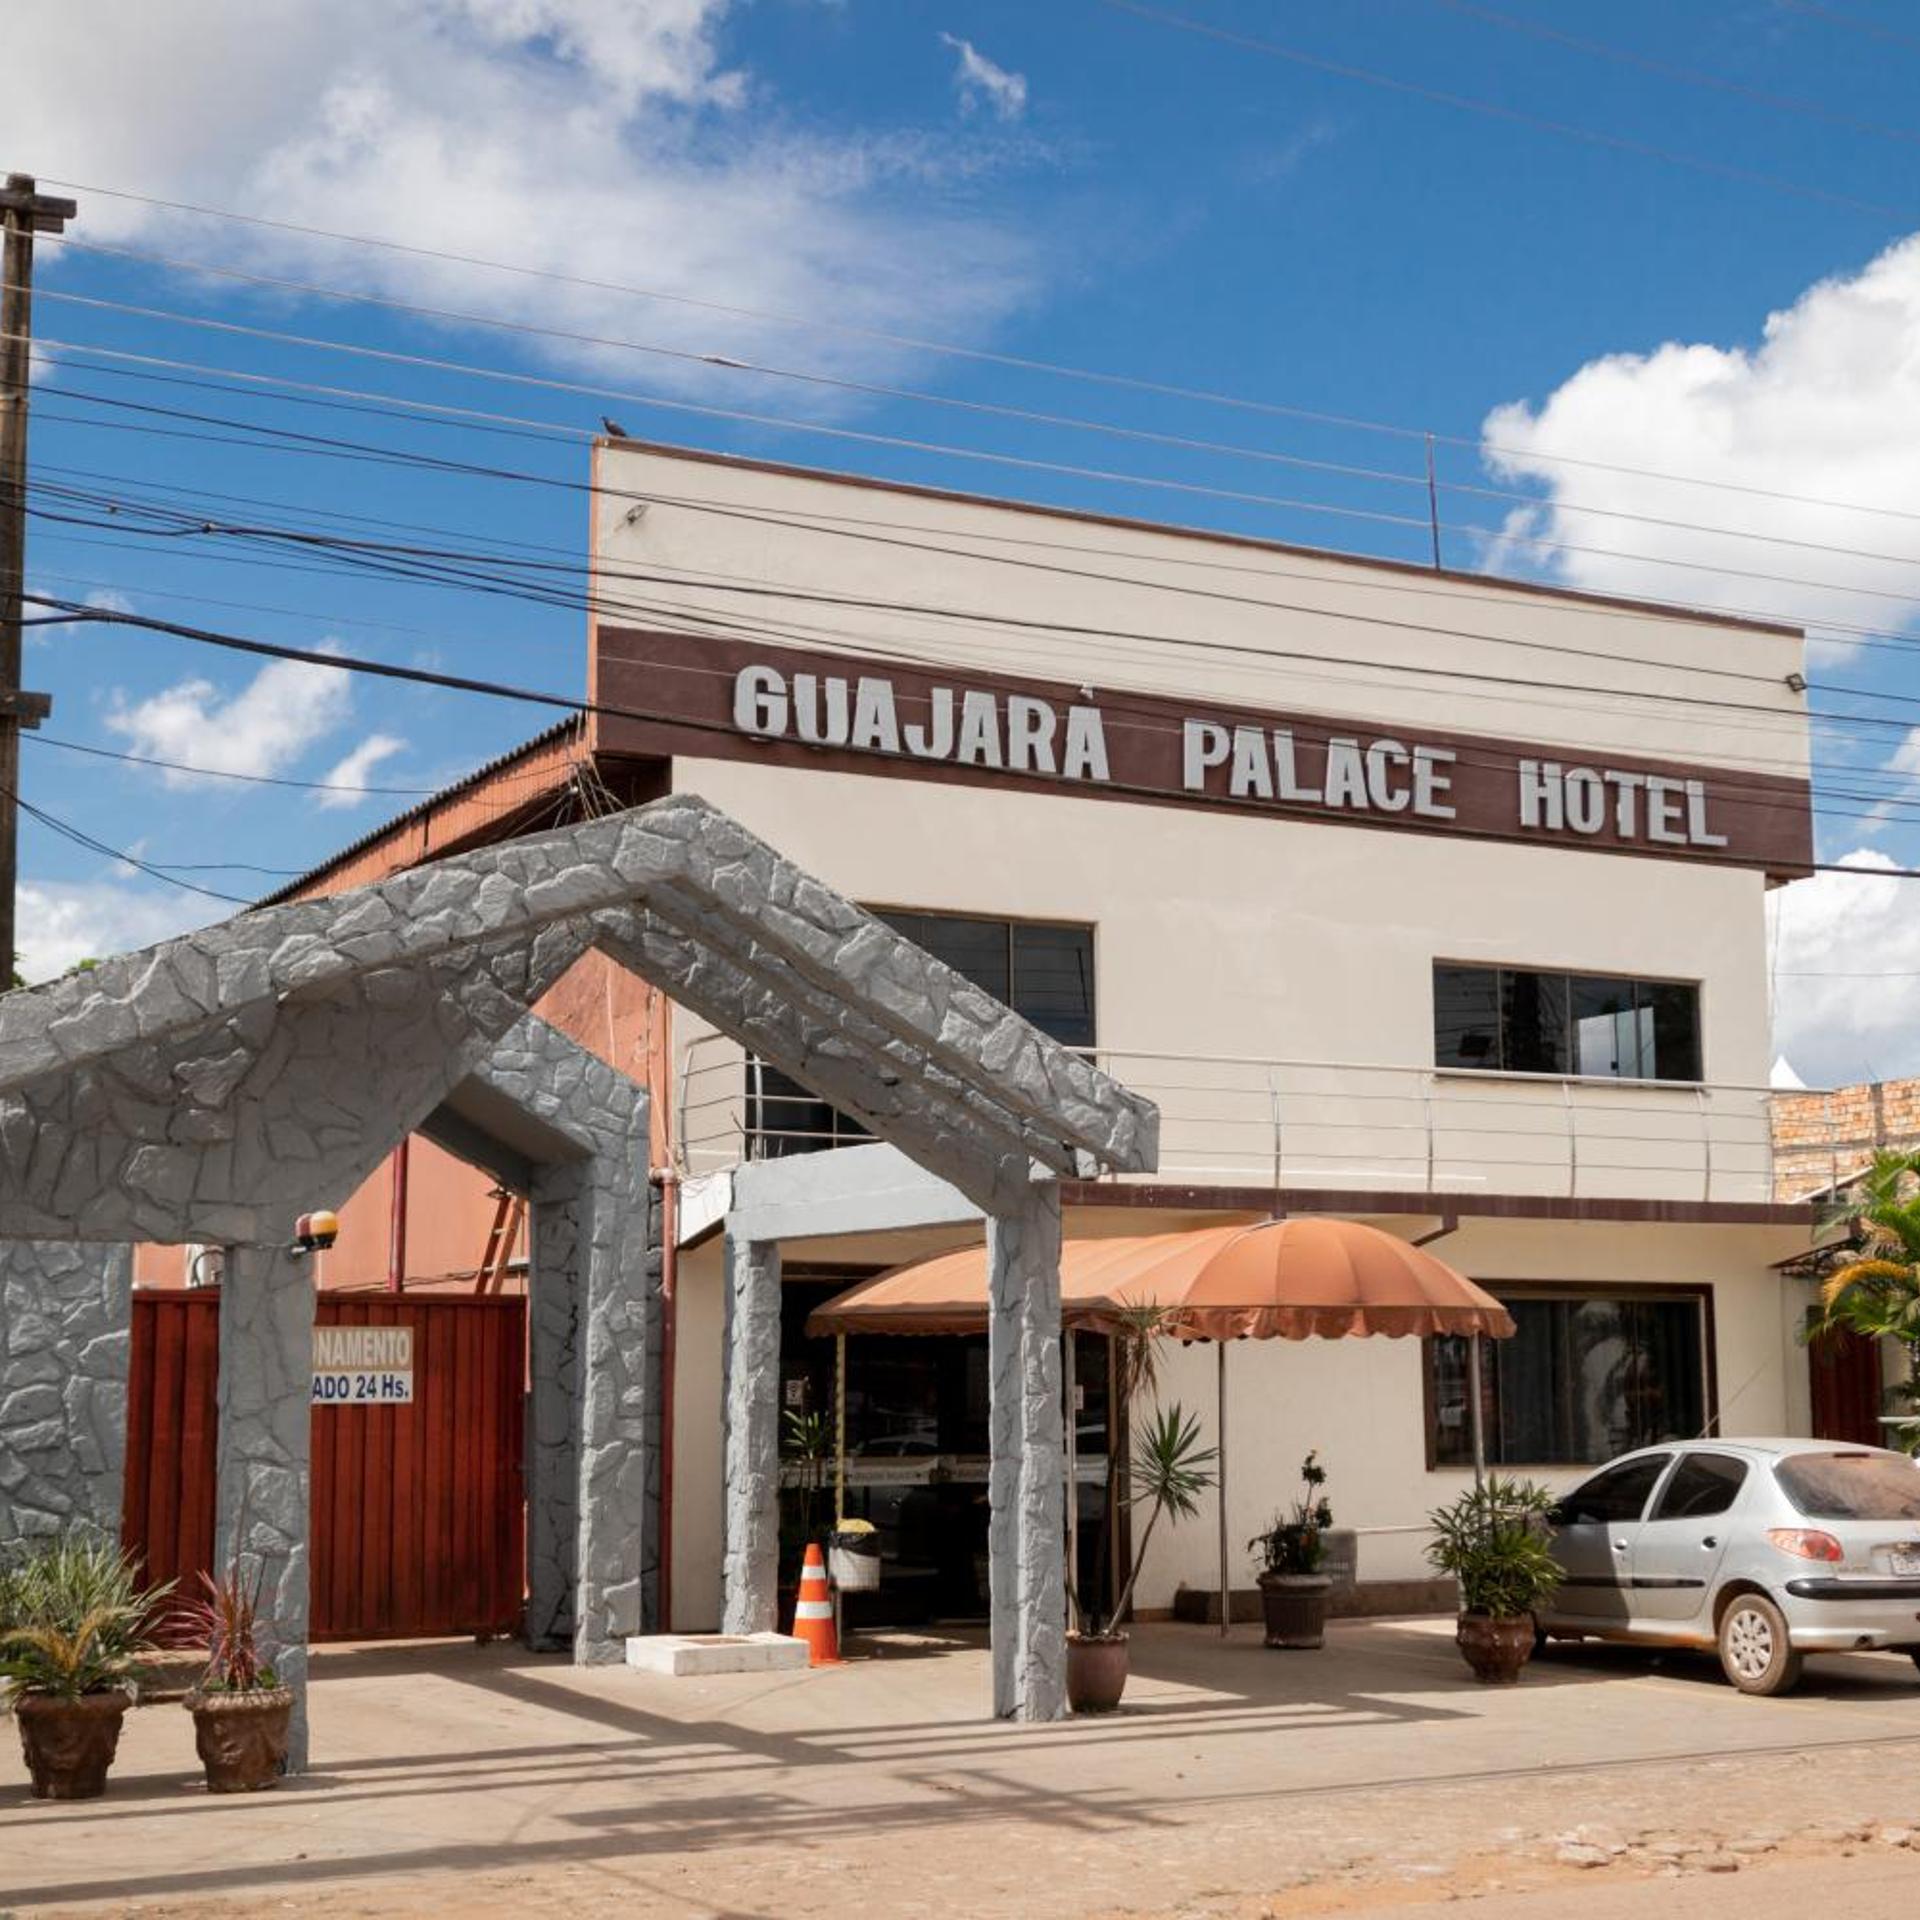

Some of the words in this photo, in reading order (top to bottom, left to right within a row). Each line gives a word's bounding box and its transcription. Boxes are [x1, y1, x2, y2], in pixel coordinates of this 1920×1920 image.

[1183, 717, 1456, 819] PALACE
[1519, 759, 1728, 847] HOTEL
[355, 1375, 378, 1399] 24
[381, 1374, 409, 1398] Hs.
